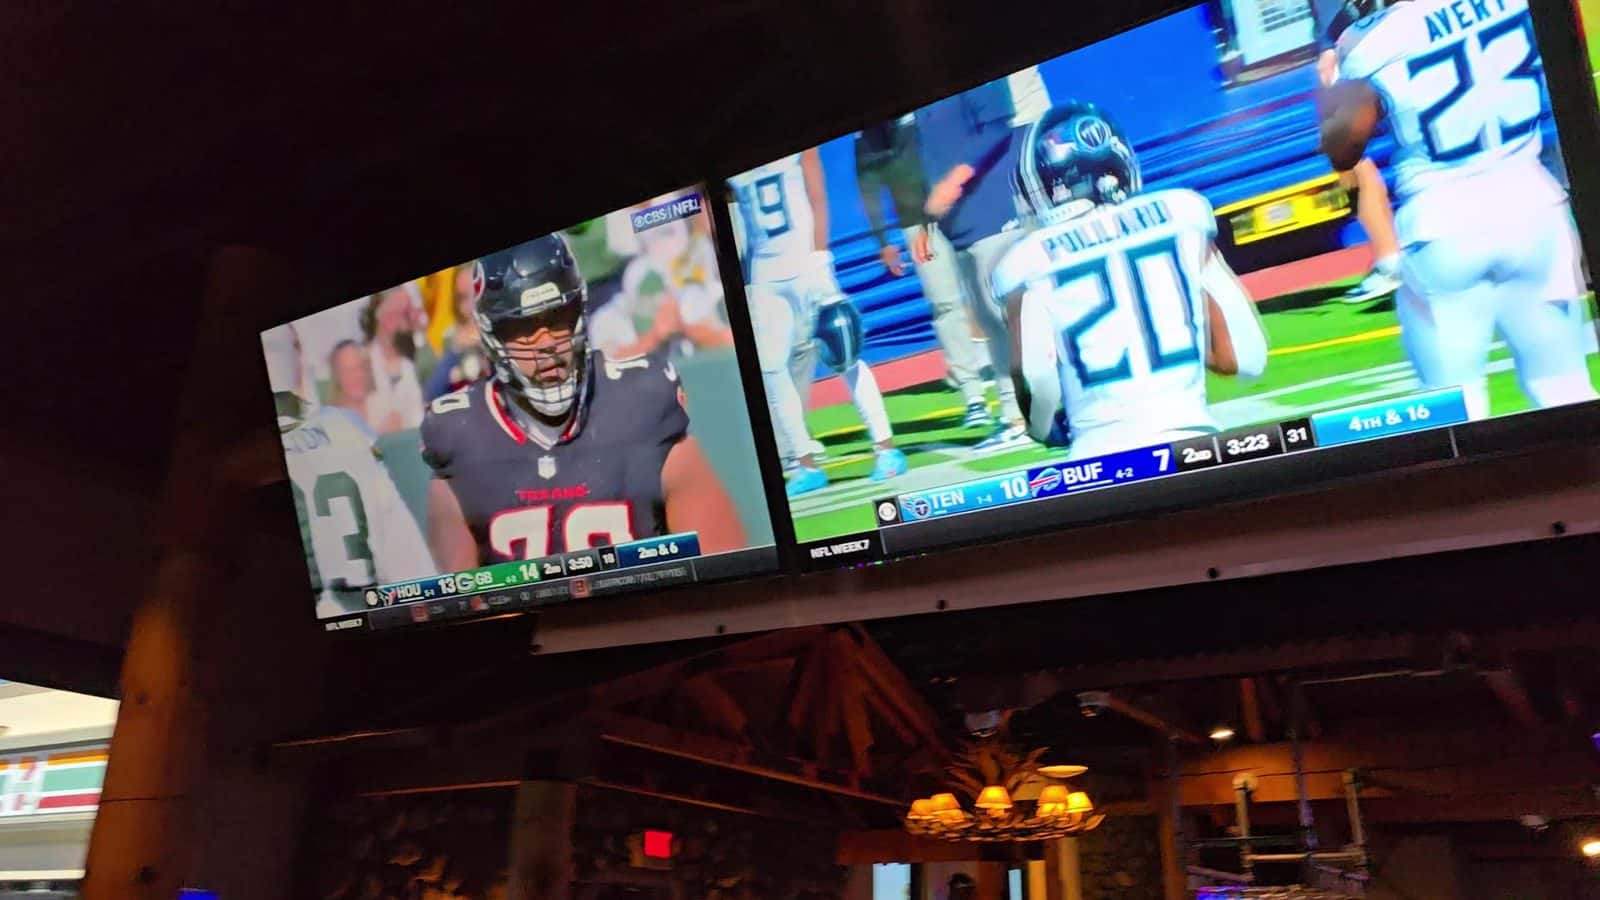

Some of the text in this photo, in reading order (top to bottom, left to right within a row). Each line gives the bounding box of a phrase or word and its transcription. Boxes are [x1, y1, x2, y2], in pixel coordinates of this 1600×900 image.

[1406, 9, 1553, 162] 23
[1054, 234, 1201, 388] 20
[931, 490, 966, 510] TEN
[1000, 476, 1029, 500] 10
[1062, 462, 1104, 485] BUF
[1152, 448, 1170, 472] 7
[1226, 433, 1270, 456] 3:23
[1286, 426, 1308, 444] 31
[1385, 409, 1403, 426] &
[1406, 404, 1431, 421] 16
[397, 584, 422, 598] HOU
[438, 577, 457, 595] 13
[519, 562, 539, 581] 14
[568, 555, 595, 572] 3:50
[669, 541, 679, 554] 6
